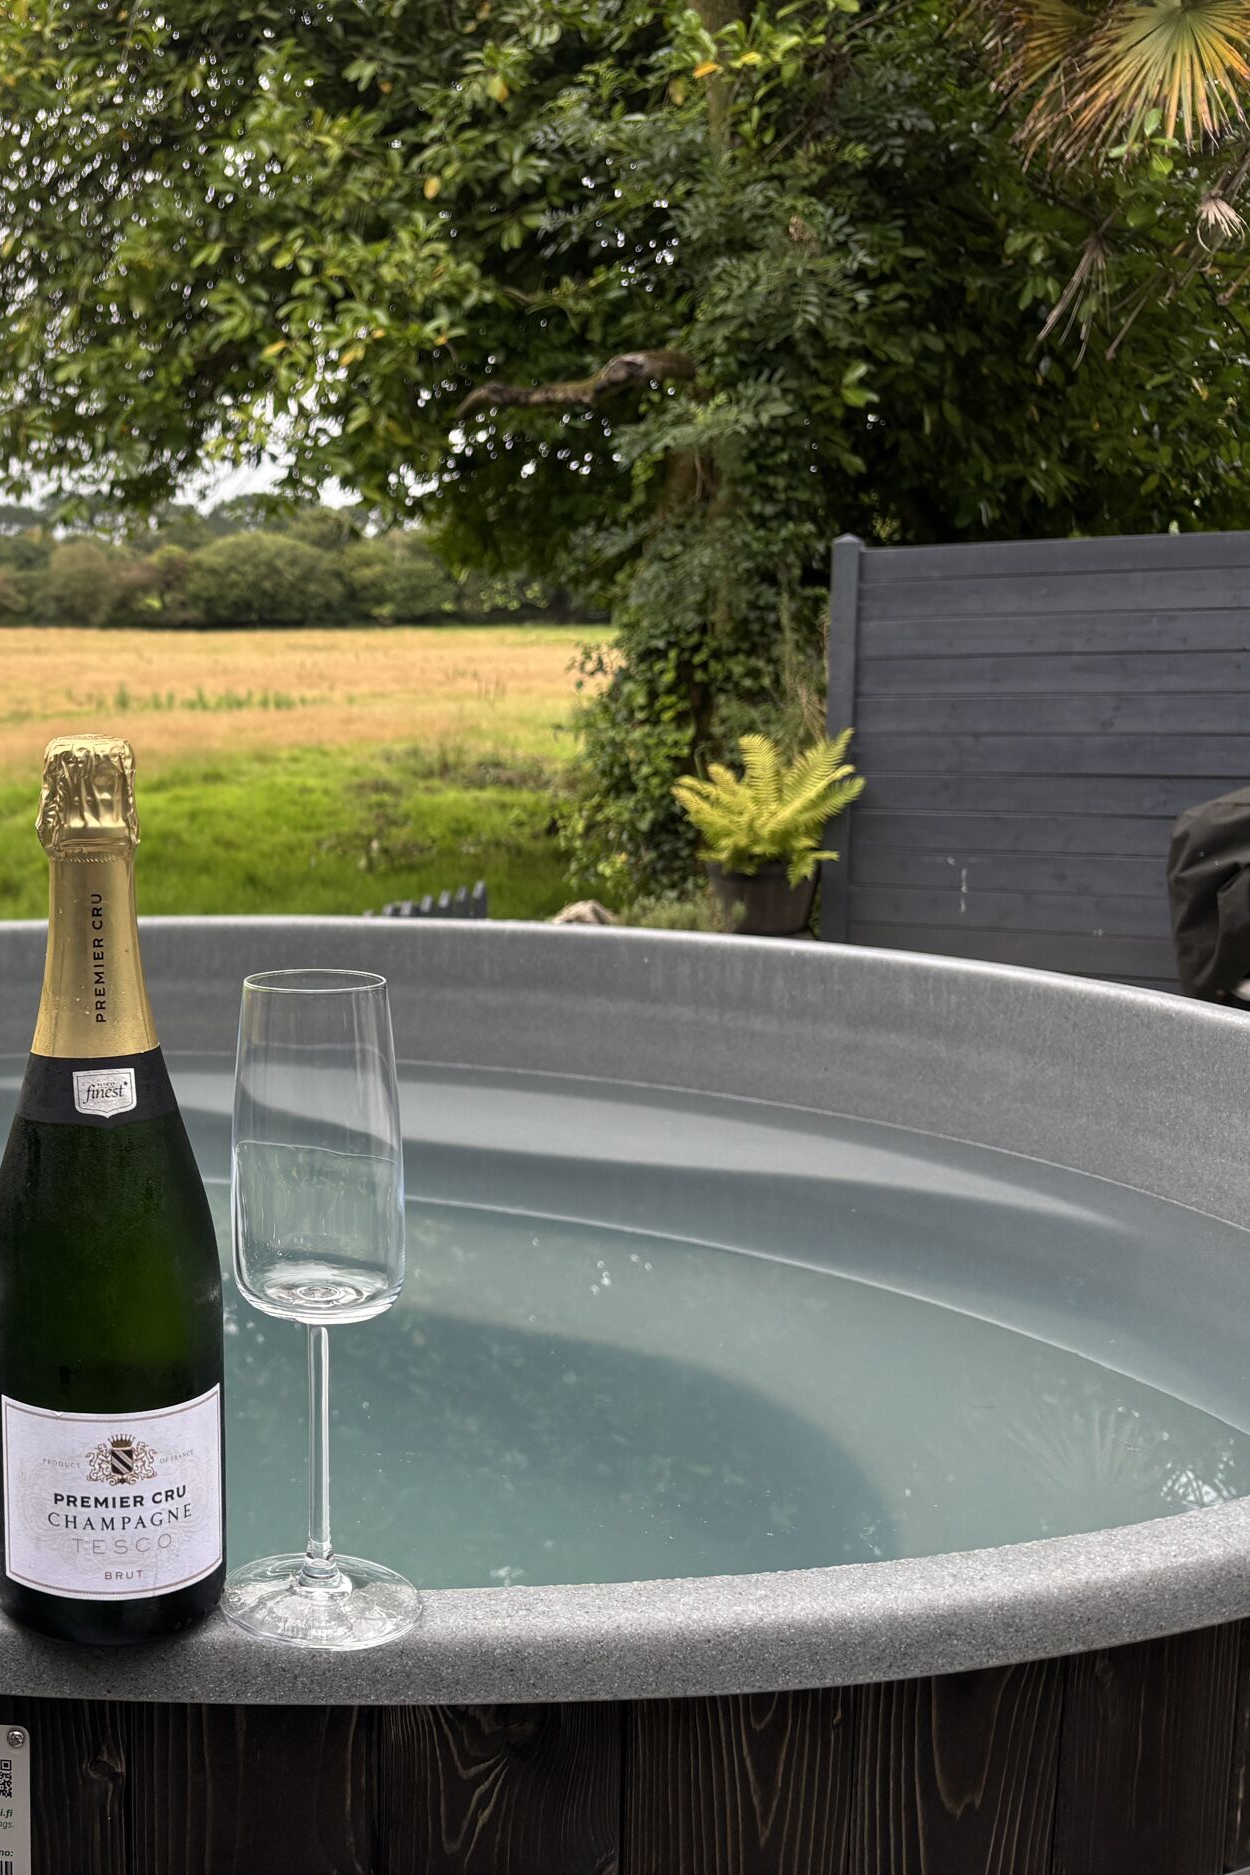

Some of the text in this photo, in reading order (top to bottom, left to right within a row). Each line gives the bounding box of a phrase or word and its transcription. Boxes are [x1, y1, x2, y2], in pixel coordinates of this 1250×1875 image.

[91, 893, 107, 1023] PREMIER CRU
[82, 1083, 125, 1105] finest
[43, 1449, 195, 1469] PRODUCT OF FRANCE
[53, 1485, 186, 1509] PREMIER CRU
[48, 1503, 192, 1531] CHAMPAGNE
[72, 1533, 173, 1555] TESCO
[104, 1569, 143, 1580] BRUT
